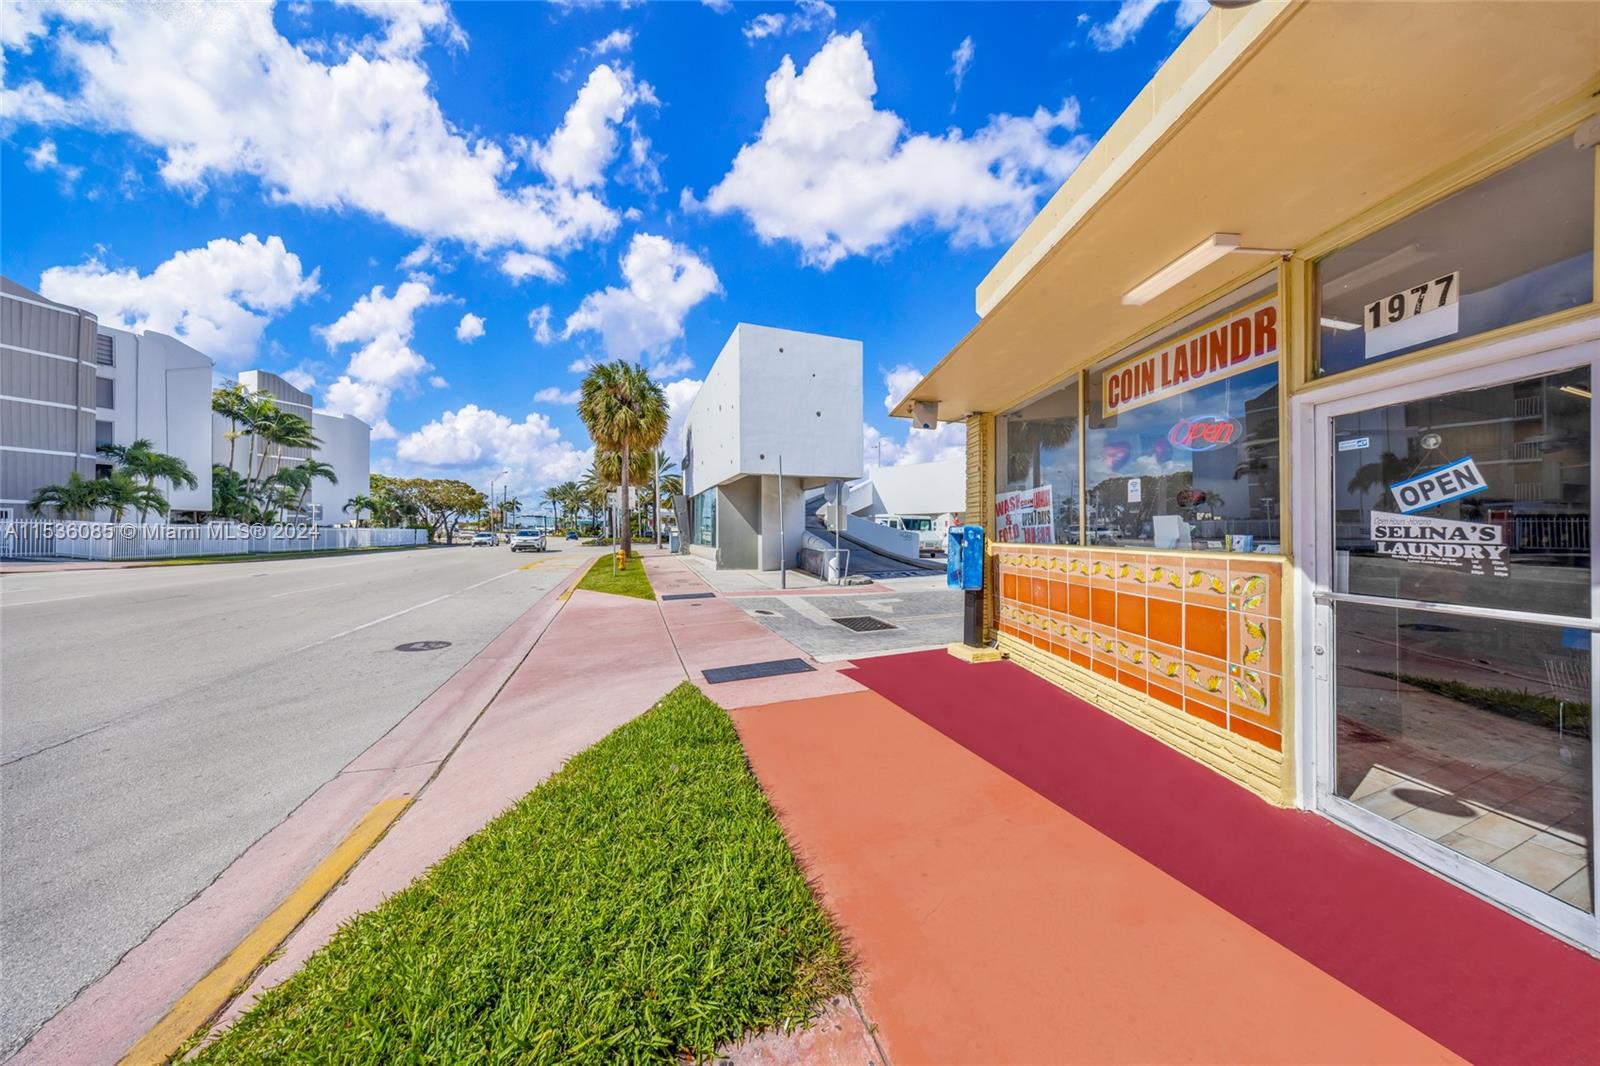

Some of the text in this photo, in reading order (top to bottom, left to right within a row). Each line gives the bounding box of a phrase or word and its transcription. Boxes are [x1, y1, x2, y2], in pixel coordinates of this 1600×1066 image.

[1368, 273, 1454, 329] 1977
[1108, 305, 1278, 409] COIN LAUNDR
[1399, 464, 1480, 507] OPEN
[1374, 525, 1497, 541] SELINA'S
[1377, 541, 1507, 560] LAUNDRY
